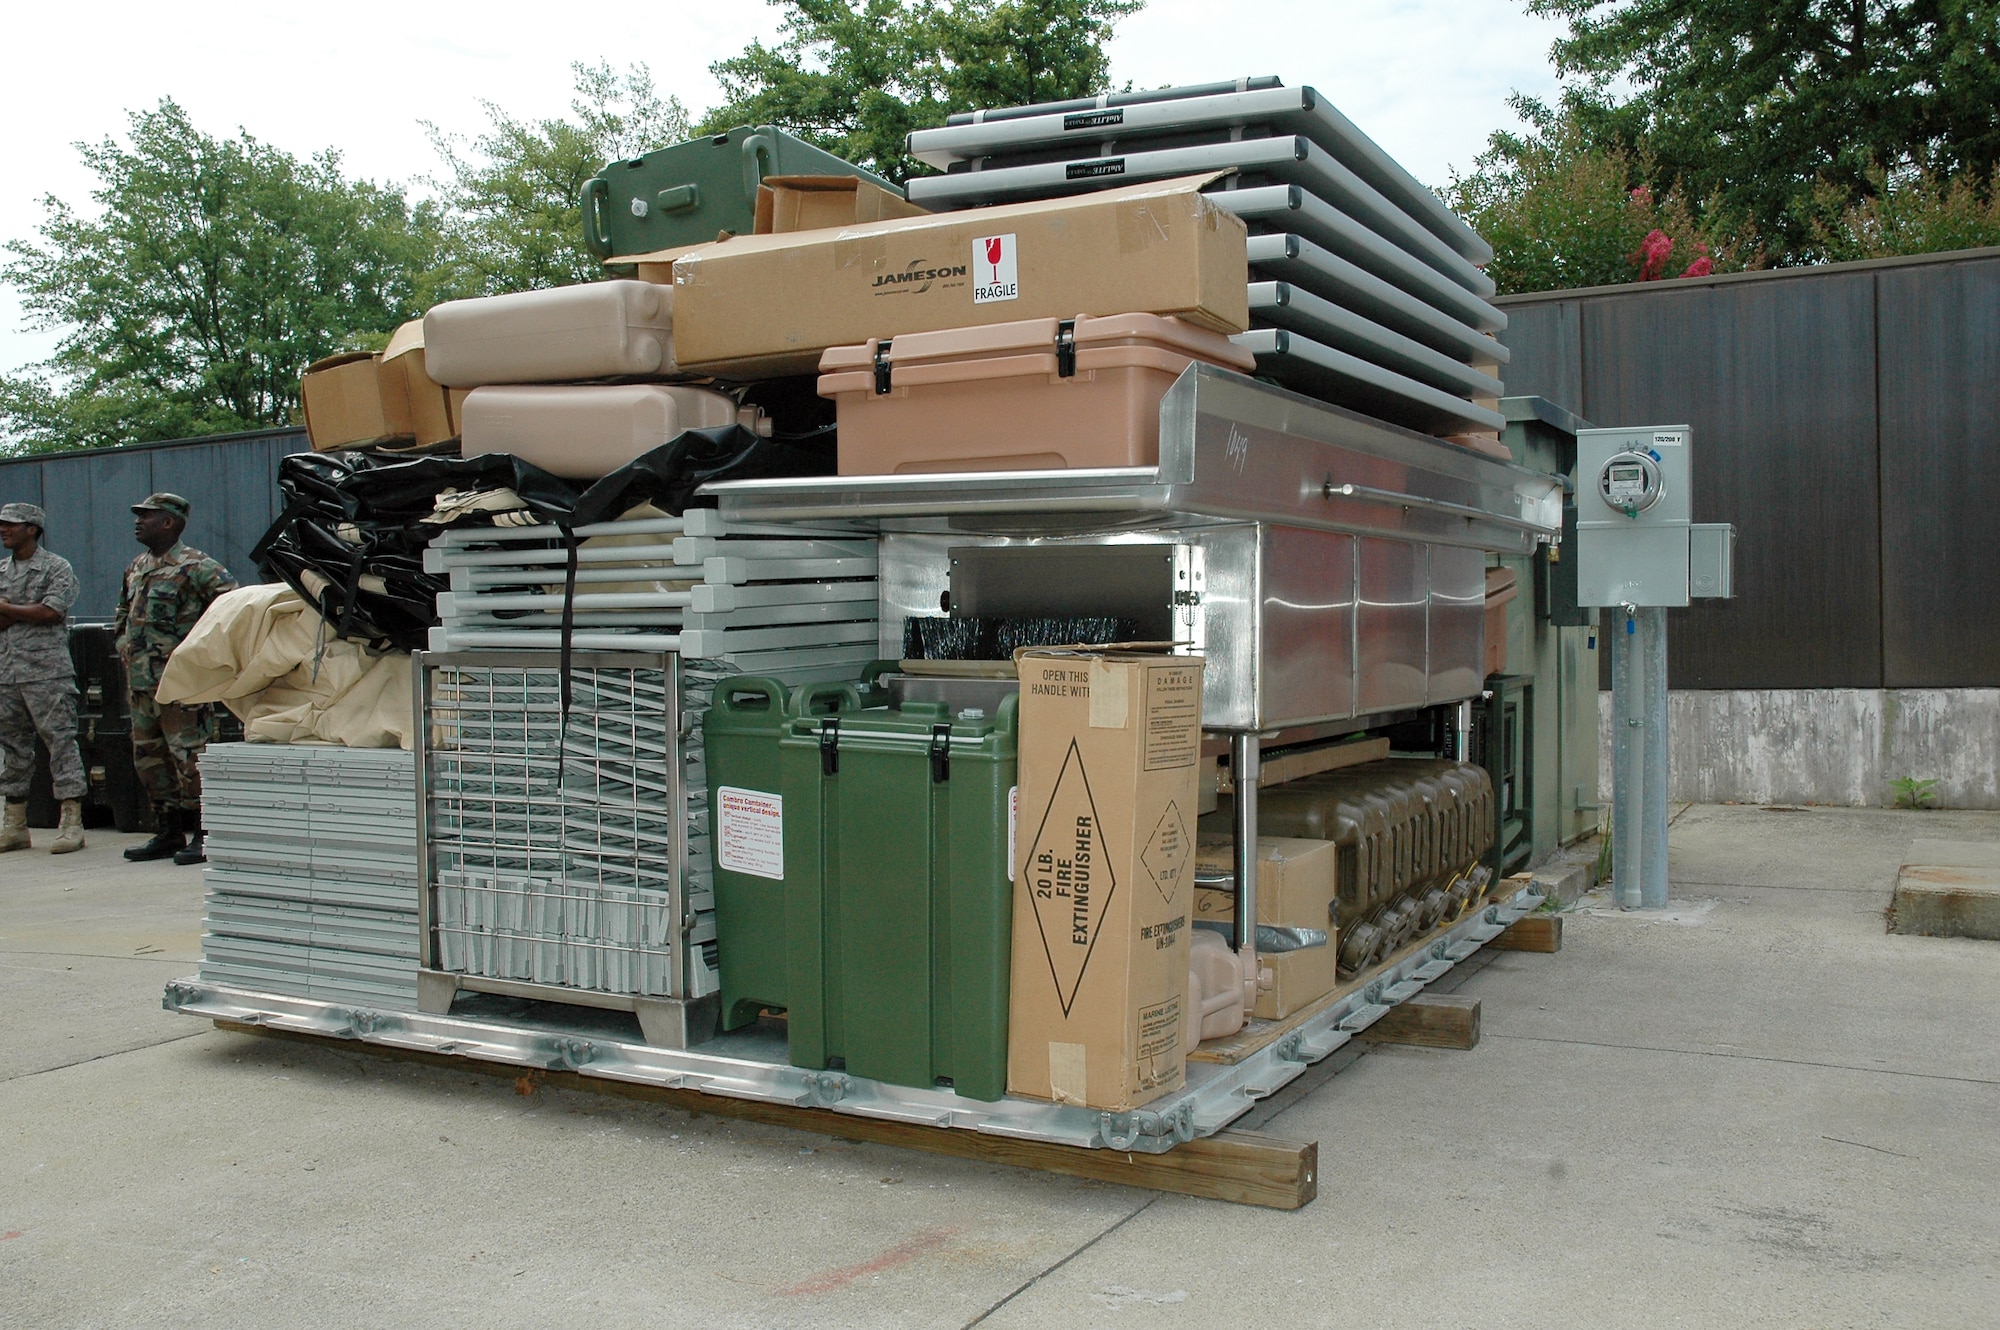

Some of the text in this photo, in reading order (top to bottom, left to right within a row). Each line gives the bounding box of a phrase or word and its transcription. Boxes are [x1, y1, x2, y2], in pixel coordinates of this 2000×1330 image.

[872, 265, 966, 287] JAMESON
[975, 283, 1016, 300] FRAGILE
[1043, 669, 1089, 683] OPEN THIS
[1157, 676, 1193, 685] DAMAGE
[1031, 684, 1067, 696] HANDLE
[741, 805, 761, 814] vertical
[1036, 849, 1053, 900] 20 LB.
[1056, 858, 1072, 898] FIRE
[1072, 815, 1092, 946] EXTINGUISHER
[1141, 926, 1153, 941] FIRE
[1143, 1007, 1164, 1020] MARINE
